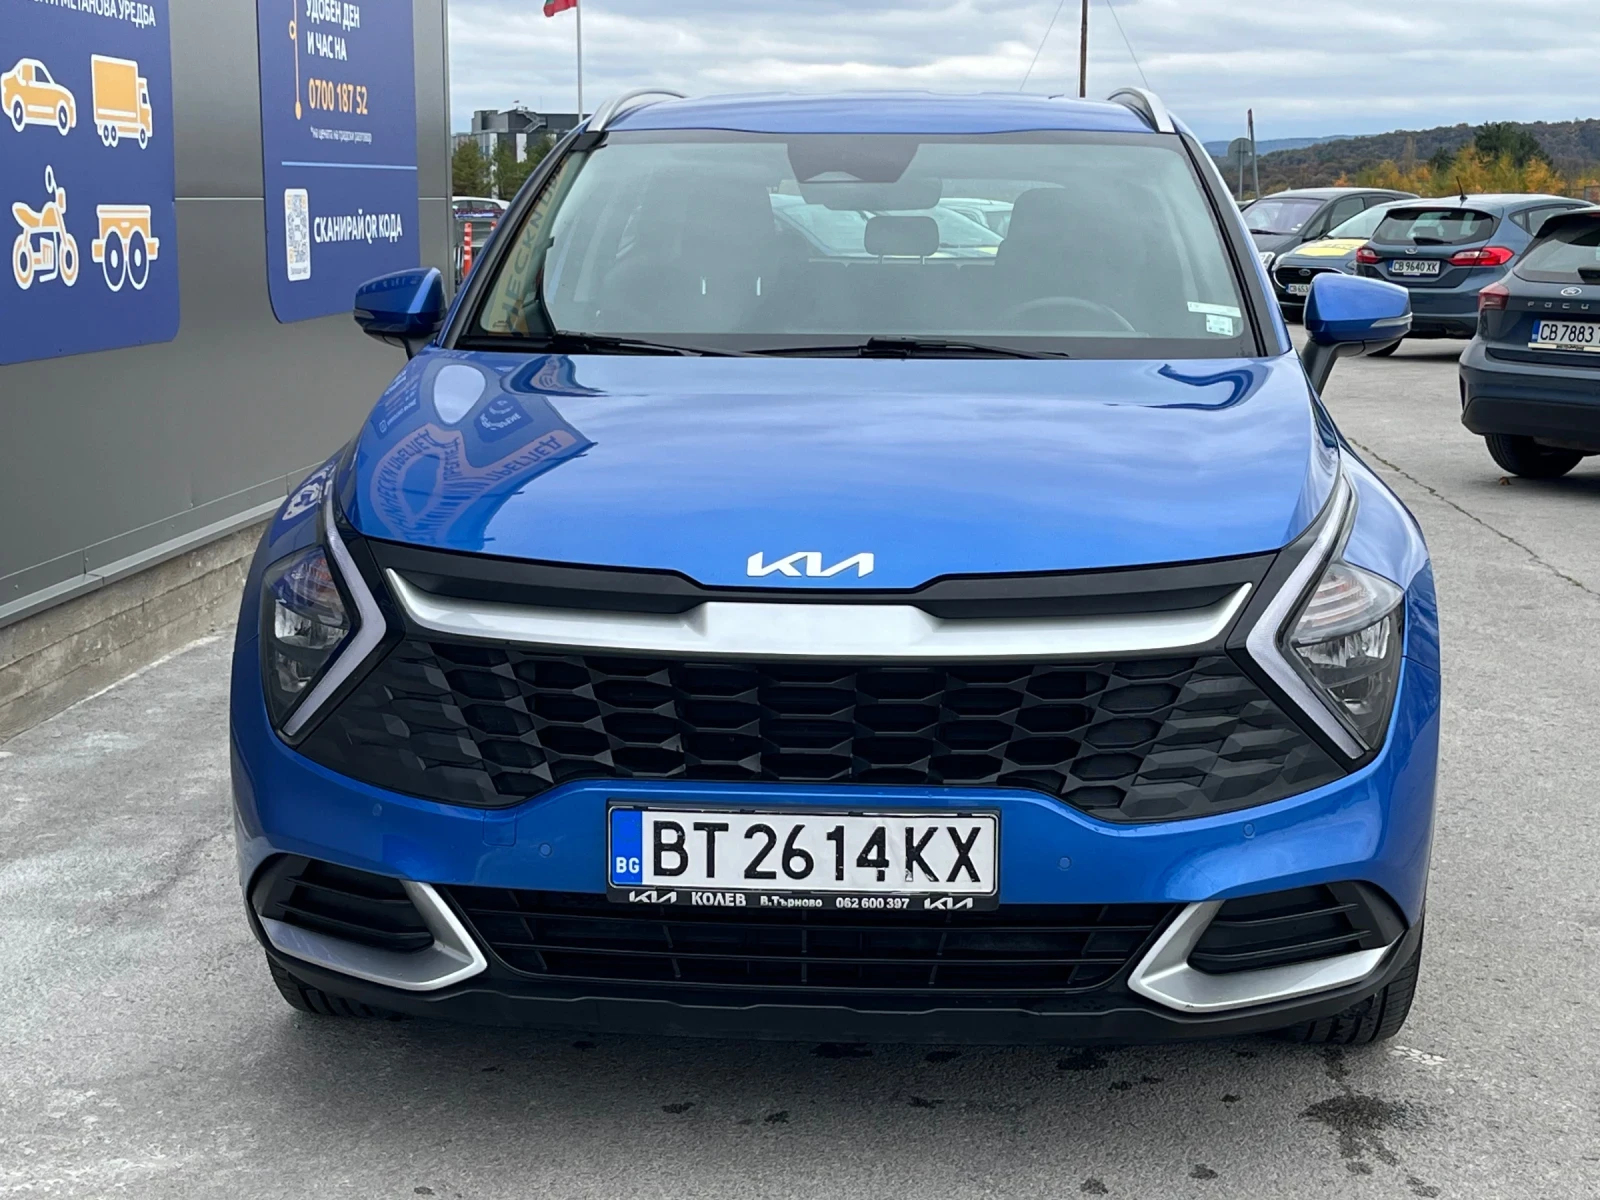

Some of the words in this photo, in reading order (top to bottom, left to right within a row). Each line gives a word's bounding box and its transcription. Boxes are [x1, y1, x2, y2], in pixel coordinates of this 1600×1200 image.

[118, 0, 156, 29] УРЕДБА
[306, 0, 341, 24] УДОБЕН
[342, 3, 360, 32] ДЕН
[307, 31, 315, 55] И
[315, 33, 333, 59] ЧАС
[335, 36, 347, 61] НА
[308, 78, 334, 111] 0700
[337, 83, 354, 113] 187
[356, 85, 368, 115] 52
[314, 208, 364, 243] СКАНИРАЙ
[365, 214, 378, 244] QR
[379, 213, 402, 243] КОДА
[1540, 323, 1558, 341] CB
[1560, 324, 1594, 343] 7883
[746, 551, 875, 578] KIA
[615, 856, 640, 874] BG
[652, 819, 730, 879] BT
[743, 823, 890, 882] 2614
[904, 825, 982, 883] KX
[691, 891, 747, 907] КОЛЕВ
[835, 897, 859, 909] 062
[861, 897, 886, 910] 600
[887, 897, 910, 910] 397
